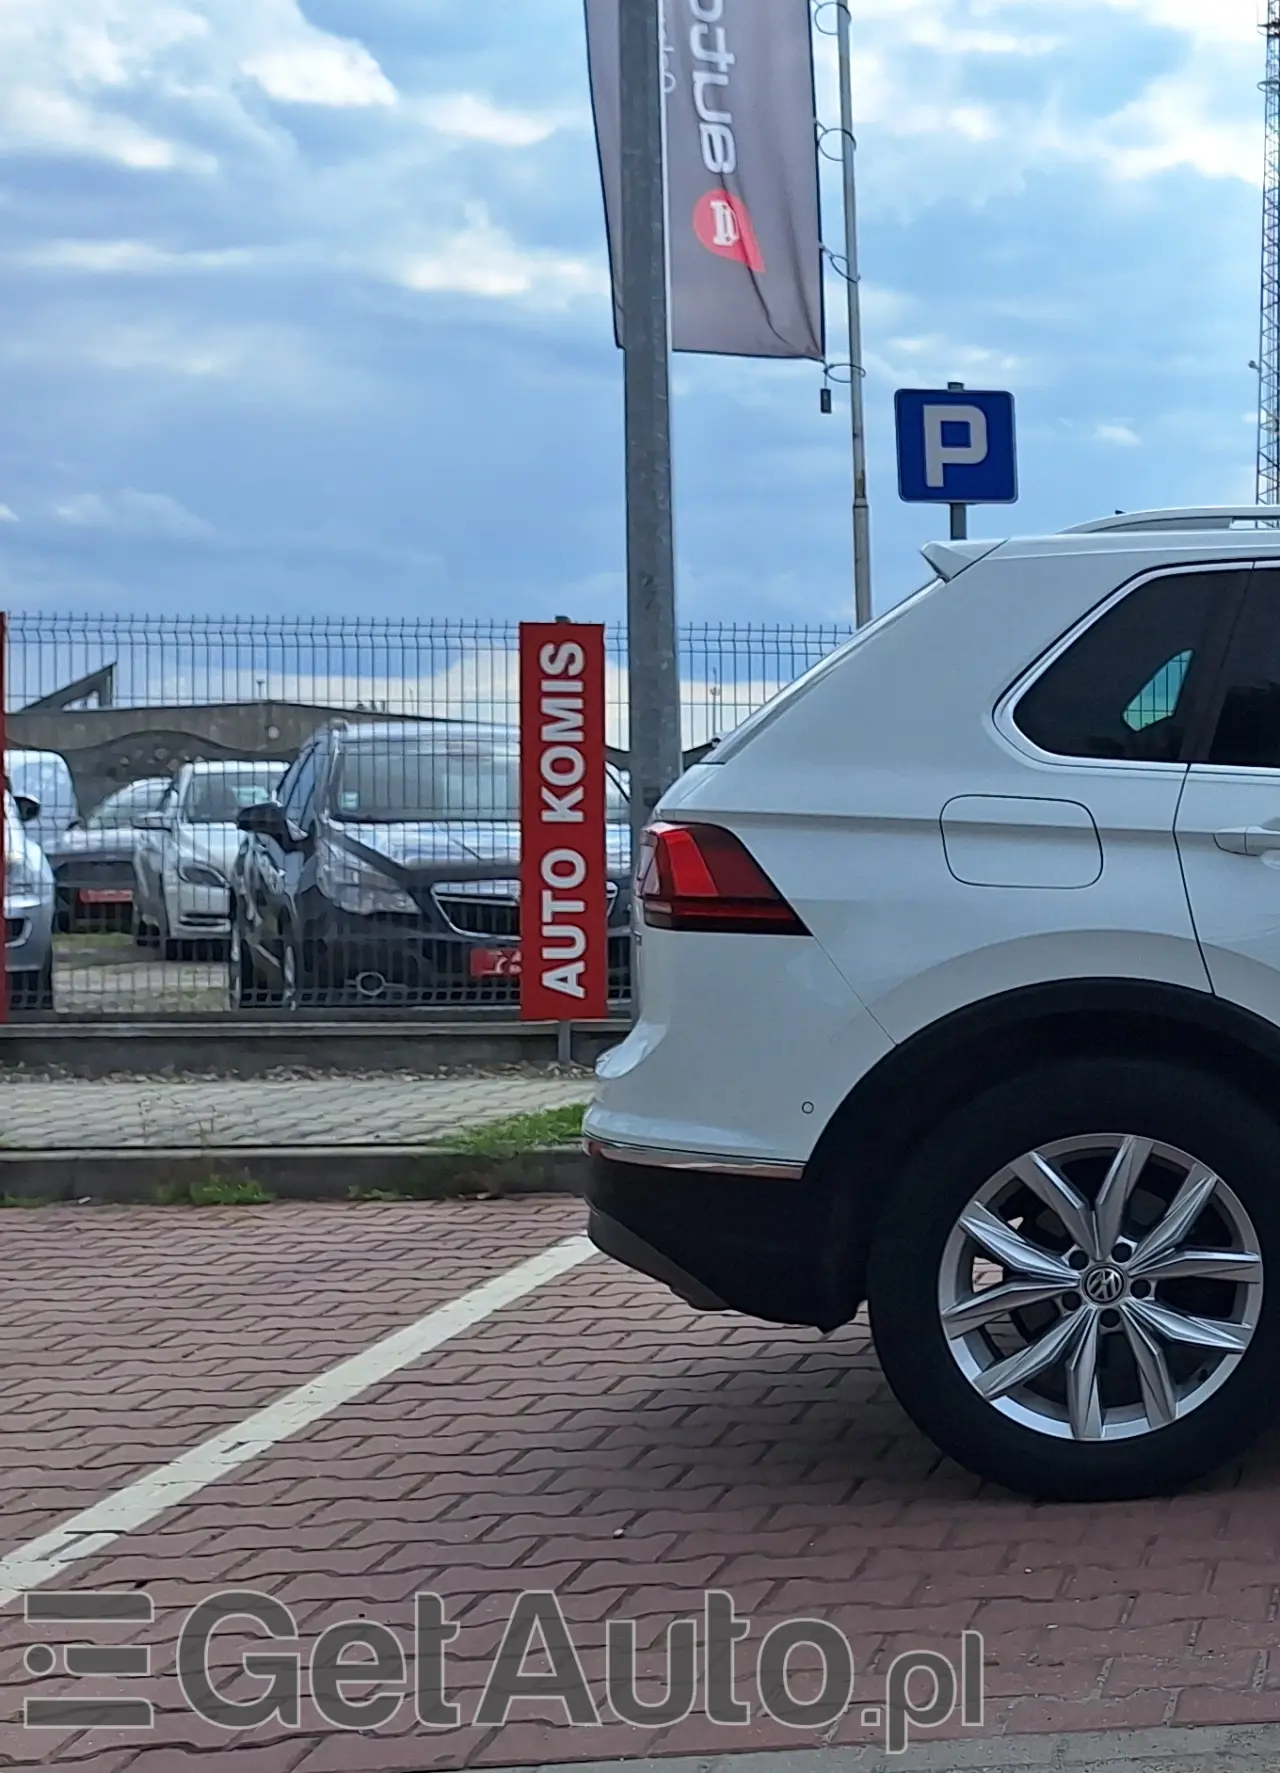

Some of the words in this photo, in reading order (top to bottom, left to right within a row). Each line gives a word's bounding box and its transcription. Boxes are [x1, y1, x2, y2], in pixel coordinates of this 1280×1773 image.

[923, 404, 988, 487] P
[539, 641, 585, 822] KOMIS
[541, 848, 587, 999] AUTO
